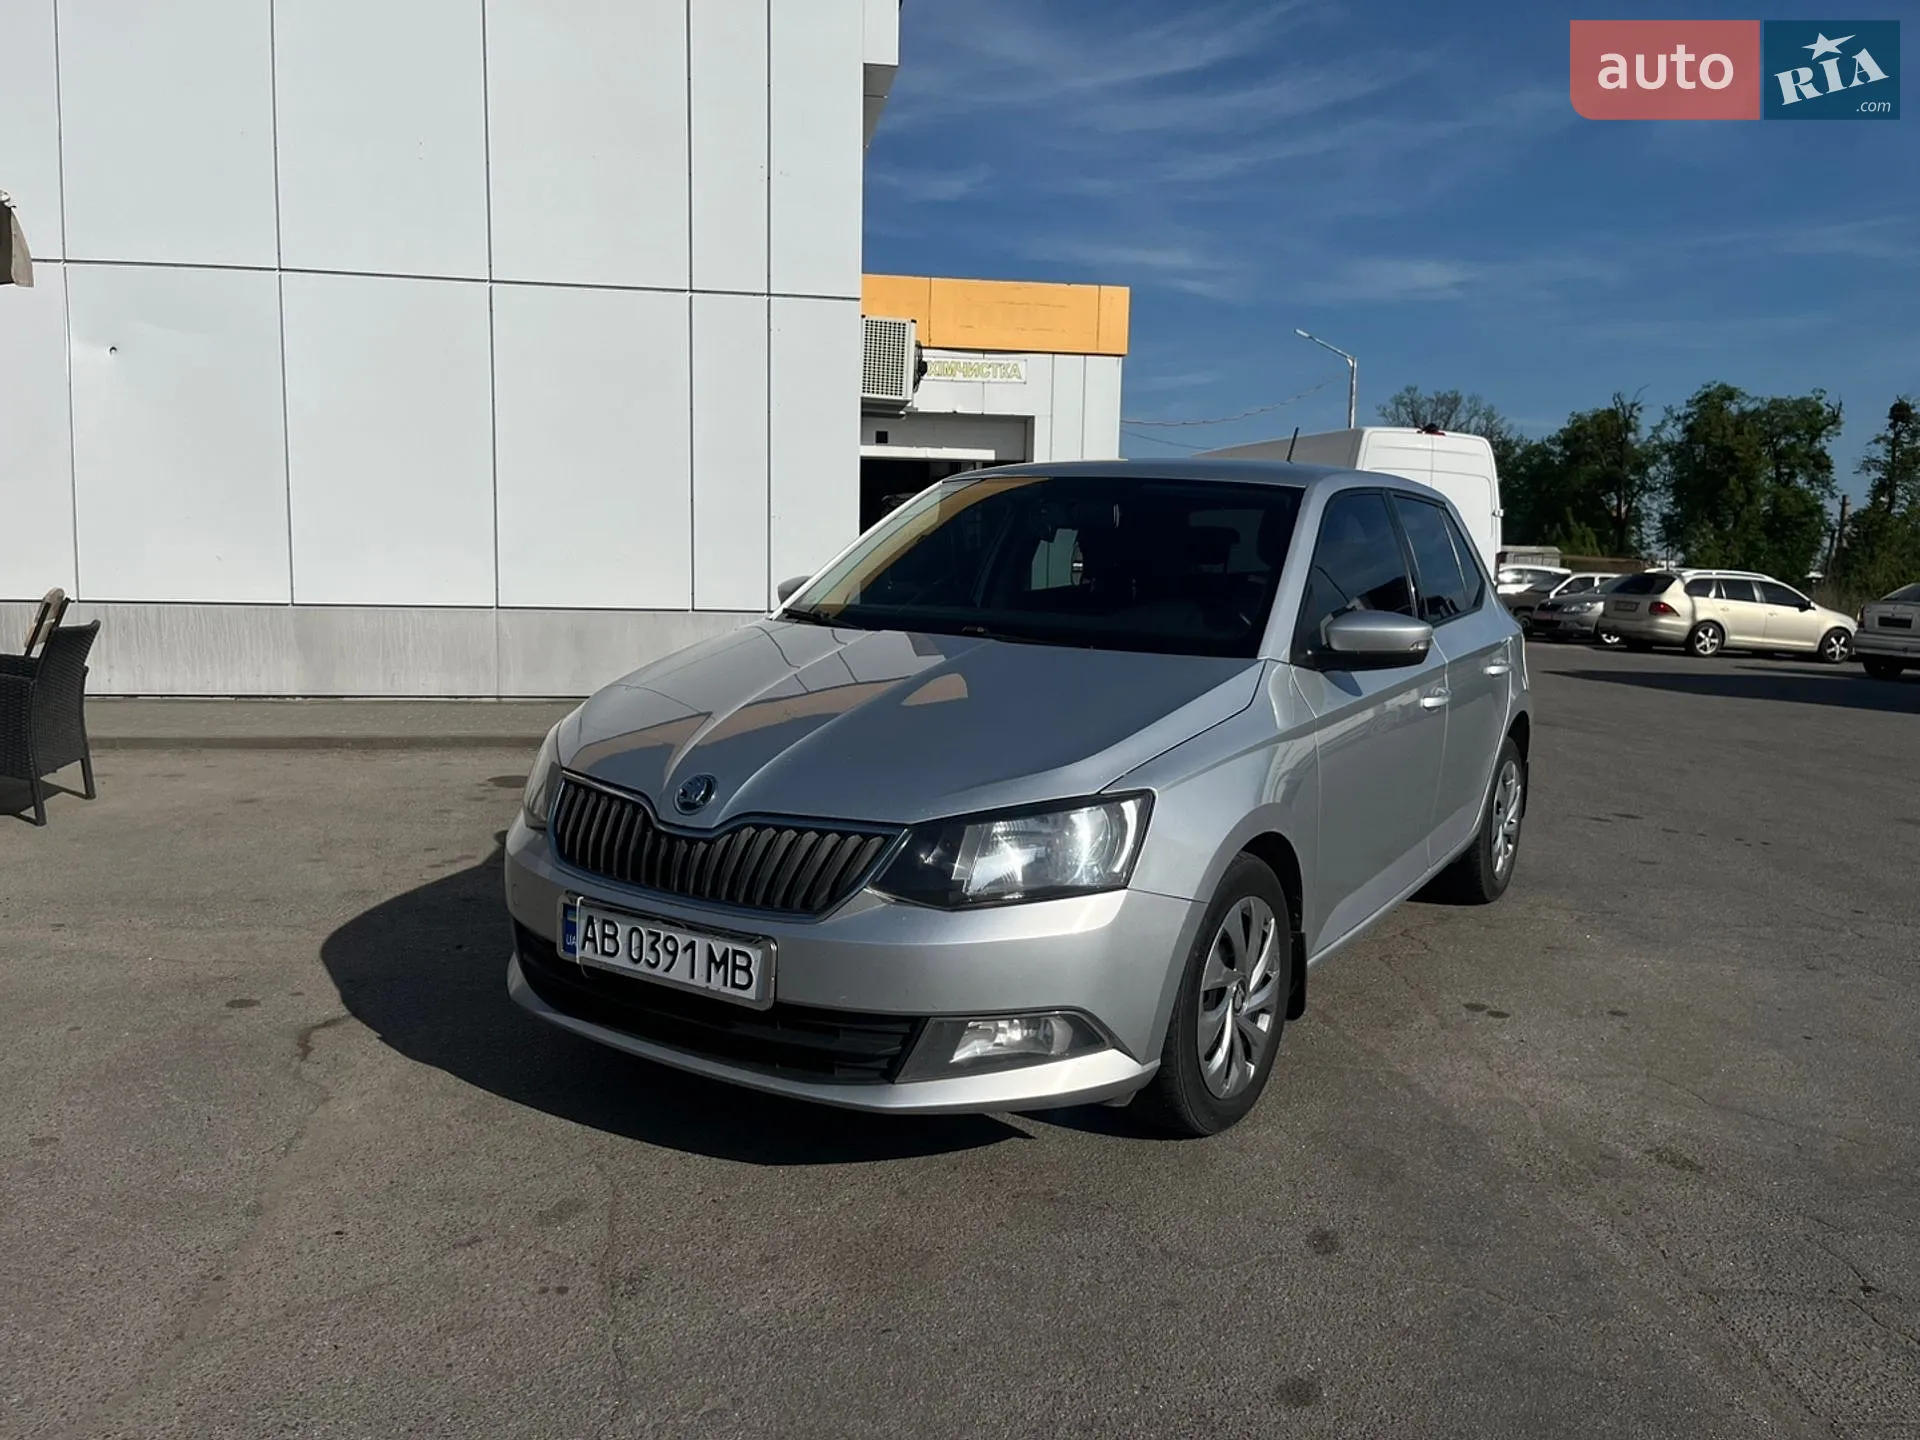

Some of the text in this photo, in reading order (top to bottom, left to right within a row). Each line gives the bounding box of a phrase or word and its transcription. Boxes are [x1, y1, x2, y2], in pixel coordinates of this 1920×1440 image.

[581, 914, 755, 991] AB 0391 MB
